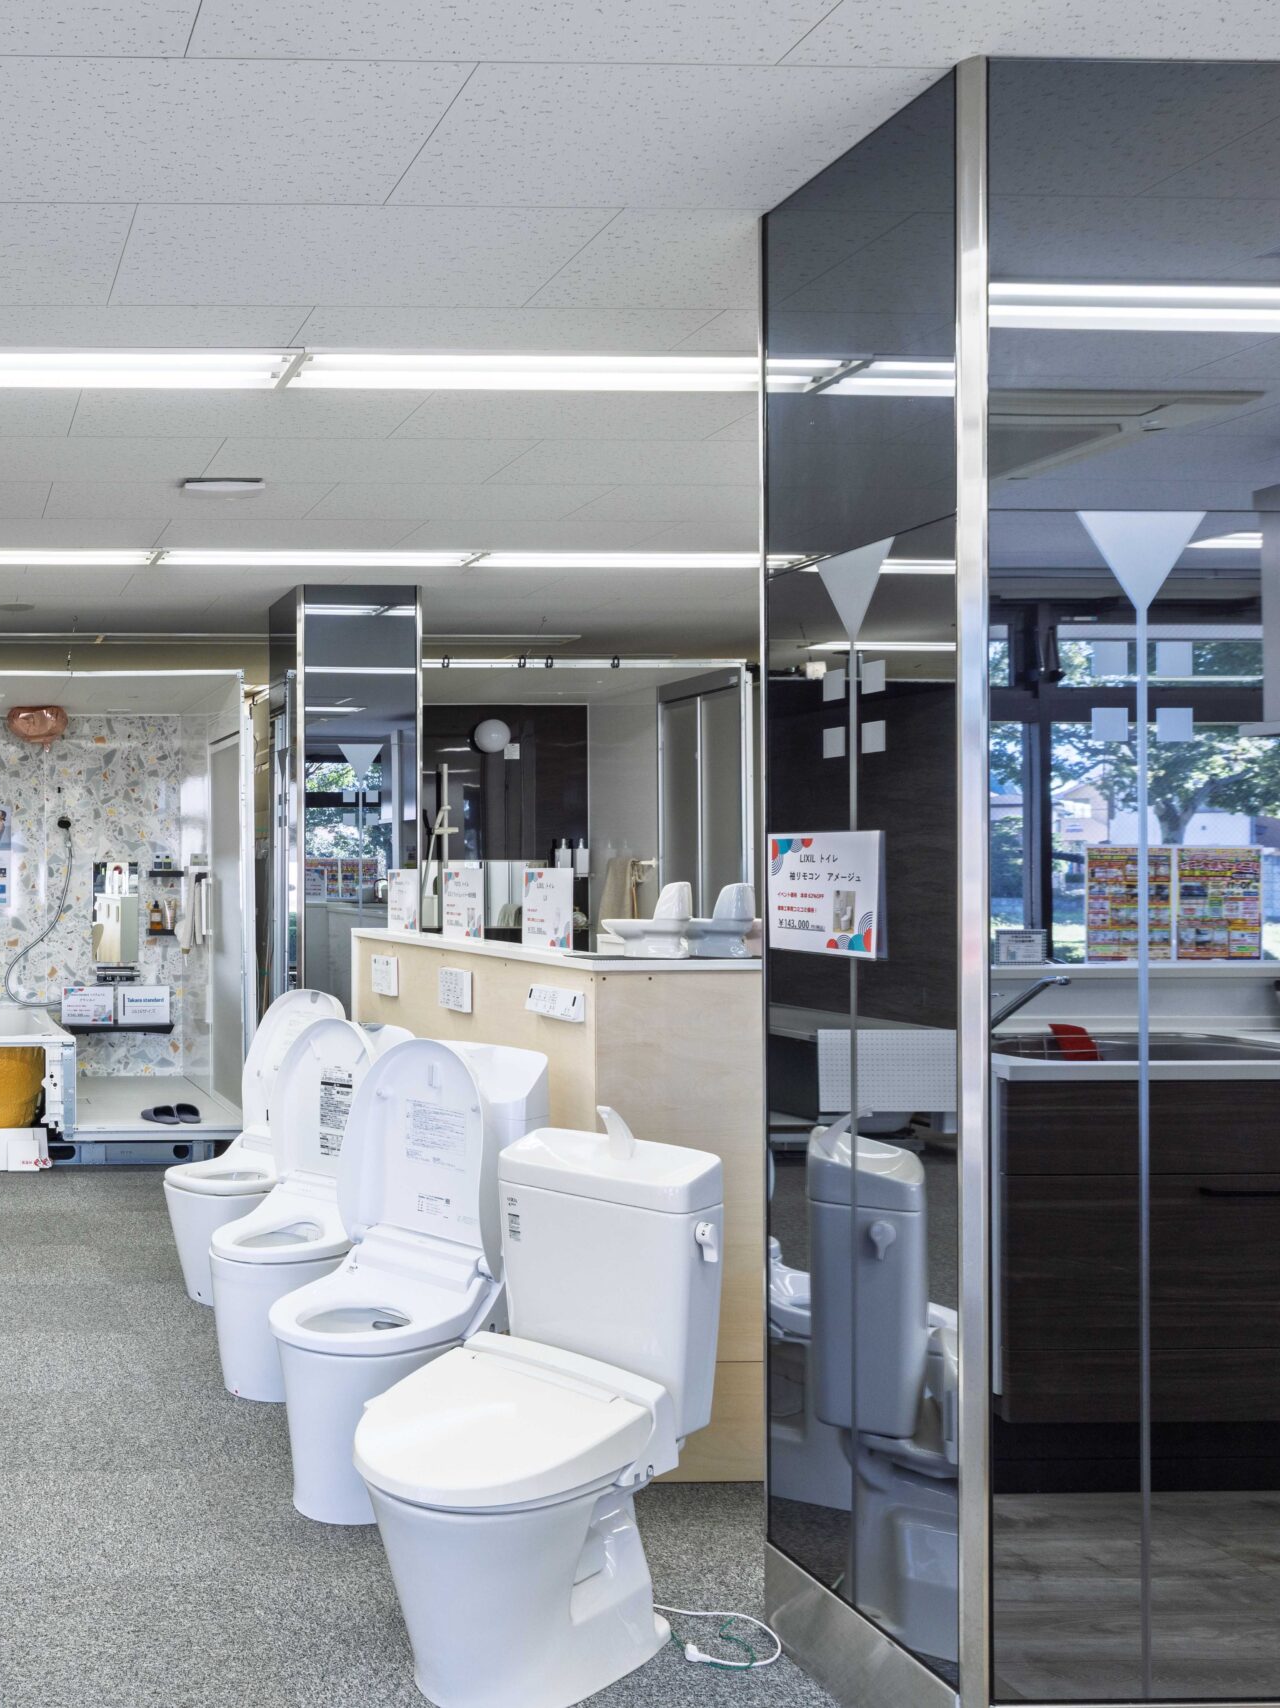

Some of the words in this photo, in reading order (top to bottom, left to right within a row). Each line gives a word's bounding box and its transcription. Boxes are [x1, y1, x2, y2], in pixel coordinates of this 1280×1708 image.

[800, 854, 816, 863] LIXIL
[820, 853, 838, 863] トイレ
[789, 871, 821, 881] 袖リモコン
[827, 872, 861, 882] アメージュ
